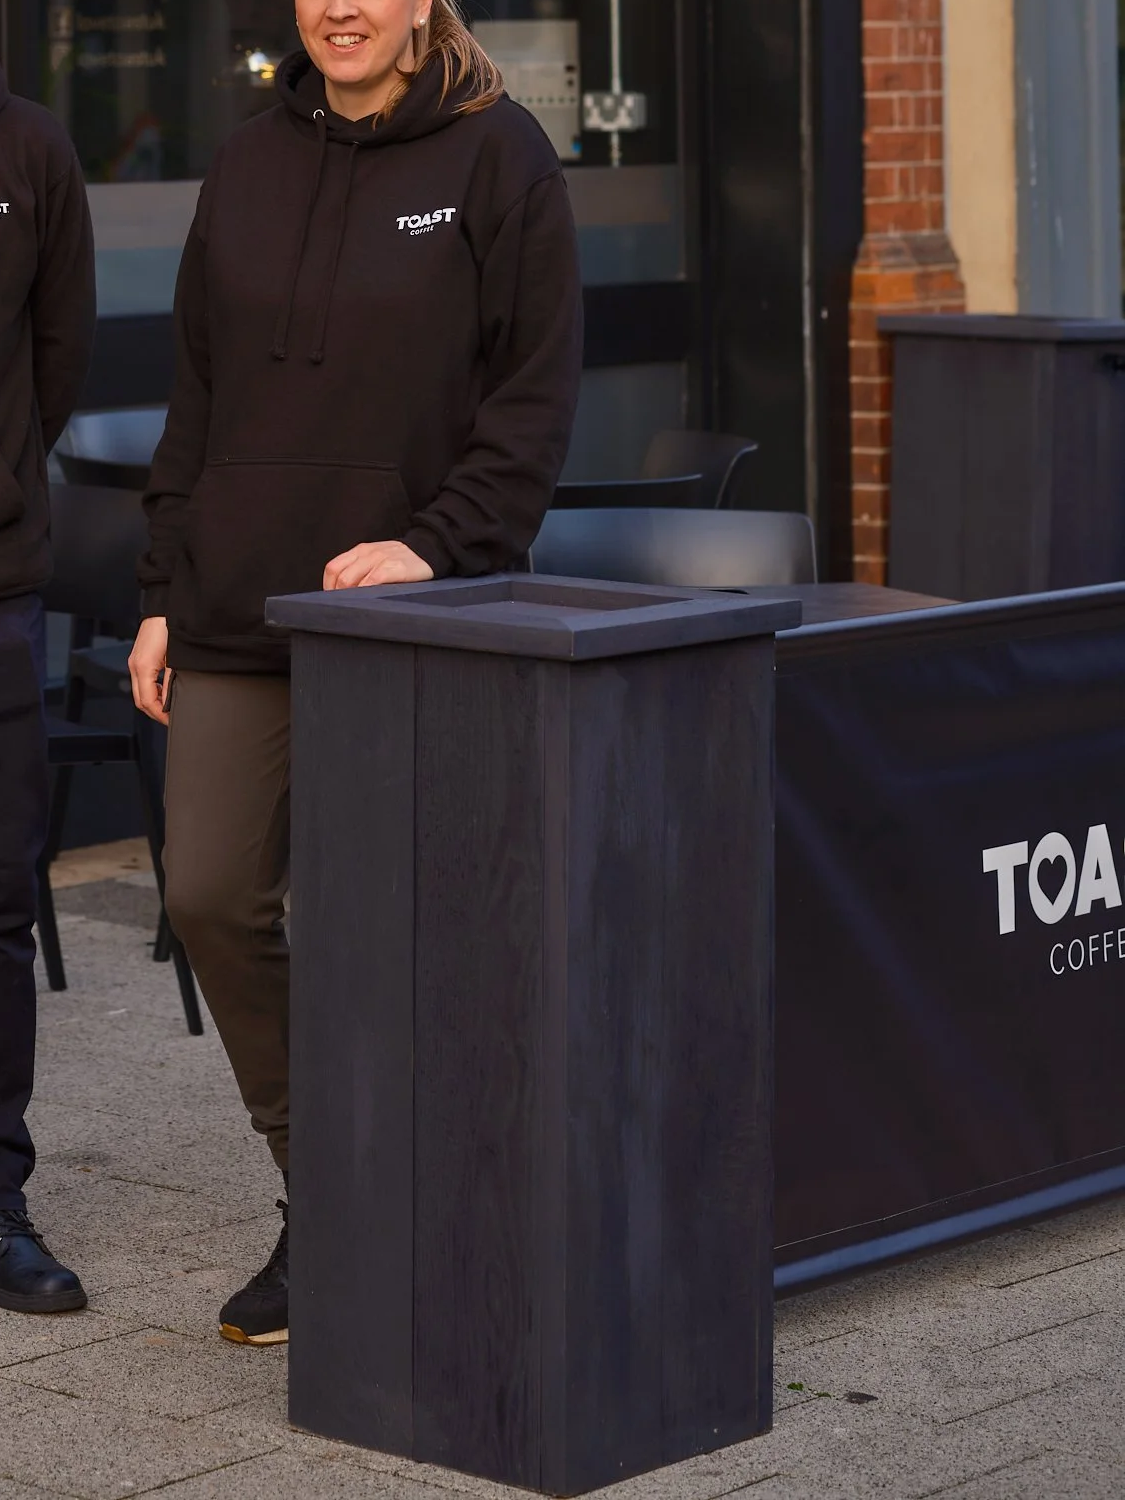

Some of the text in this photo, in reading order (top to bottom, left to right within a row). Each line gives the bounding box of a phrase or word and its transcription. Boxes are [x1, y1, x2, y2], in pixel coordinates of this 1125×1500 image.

[396, 207, 457, 230] TOAST
[409, 225, 434, 236] COFFEE
[982, 823, 1125, 935] TOA
